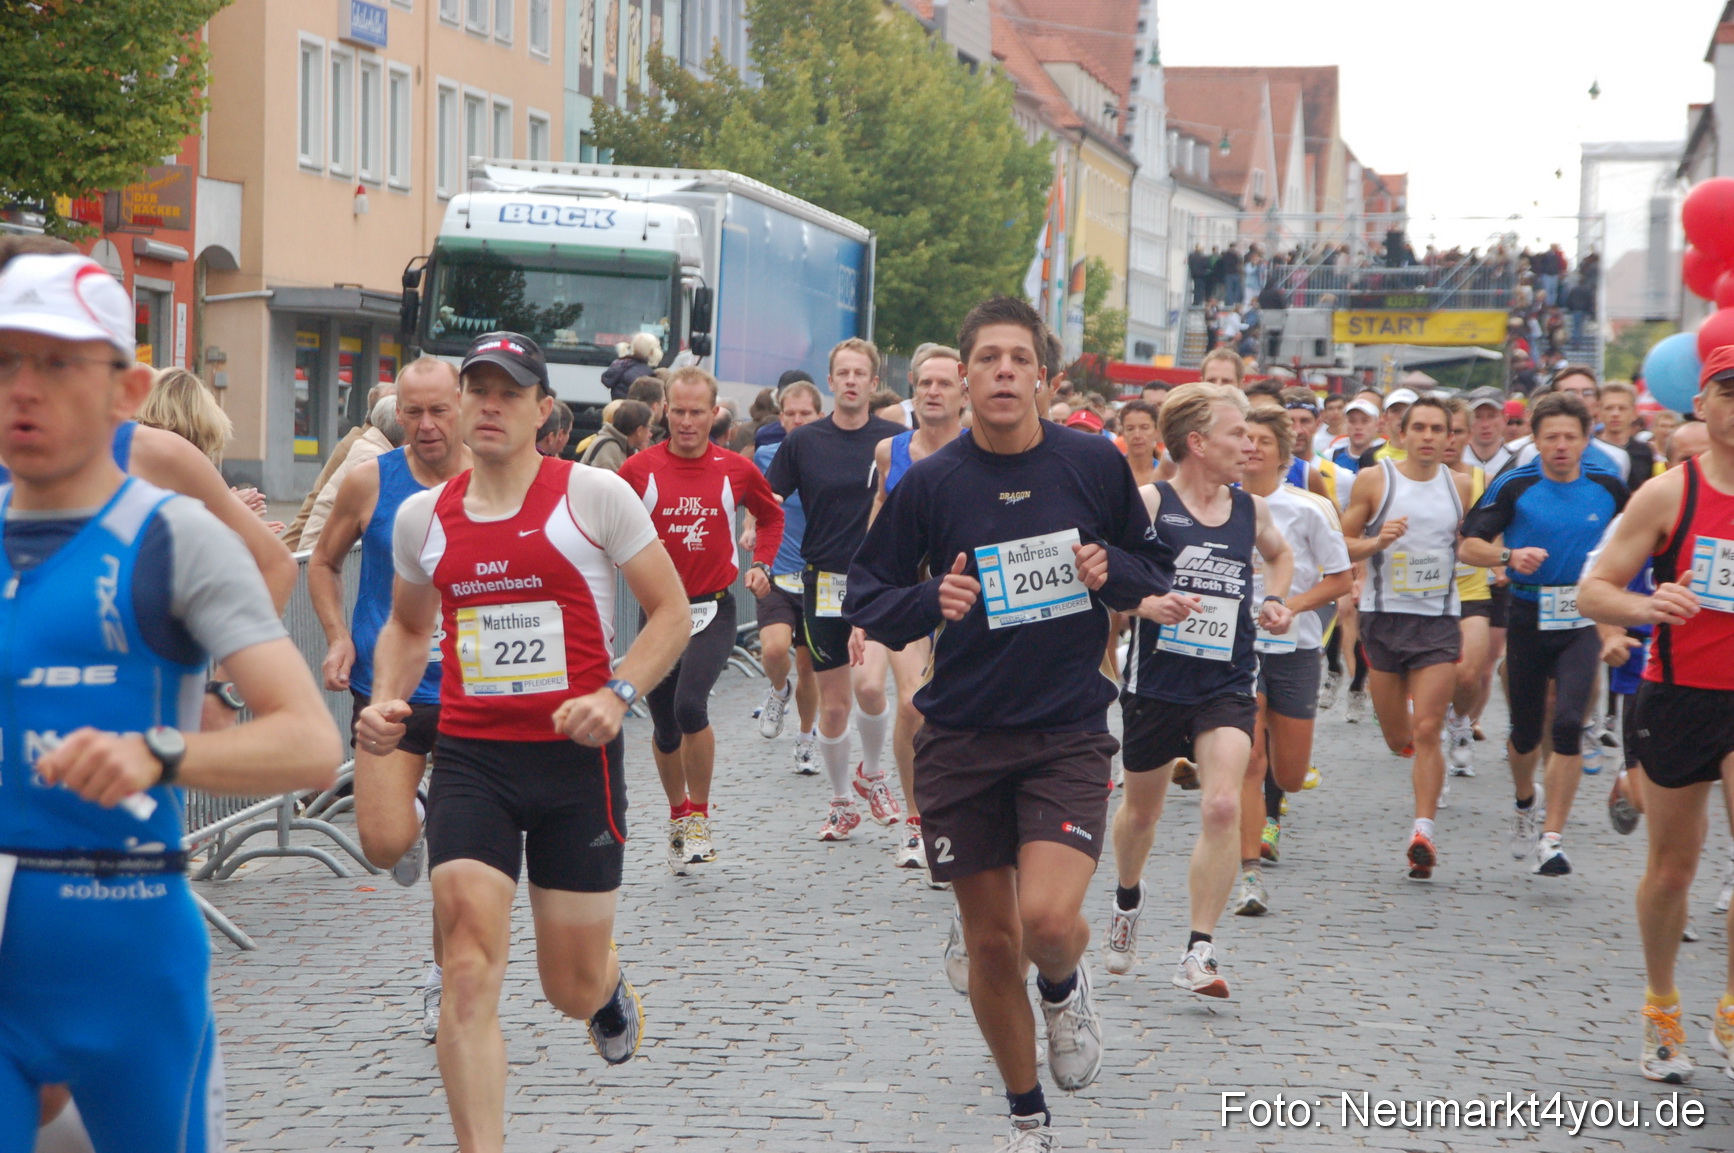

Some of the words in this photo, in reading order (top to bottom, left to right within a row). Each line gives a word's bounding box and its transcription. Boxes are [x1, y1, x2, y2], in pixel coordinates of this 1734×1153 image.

[499, 203, 617, 229] BOCK
[1348, 316, 1429, 336] START
[679, 497, 703, 512] DJK
[999, 490, 1031, 501] DRAGON
[1008, 545, 1059, 565] Andreas
[1409, 556, 1439, 565] Joachim
[475, 560, 509, 576] DAV
[1185, 557, 1242, 578] NAGEL
[1415, 568, 1439, 583] 744
[451, 575, 543, 597] Röthenbach
[990, 577, 996, 588] A
[1013, 563, 1074, 595] 2043
[1192, 577, 1222, 591] Roth
[1225, 582, 1241, 594] 52
[1719, 568, 1734, 587] 3
[690, 608, 707, 616] ang
[1051, 598, 1089, 613] PFLEIDERER
[1560, 600, 1577, 612] 29
[483, 612, 541, 631] Matthias
[1185, 618, 1228, 638] 2702
[462, 643, 468, 655] A
[494, 639, 546, 666] 222
[17, 664, 118, 687] JBE
[934, 836, 955, 864] 2
[60, 879, 168, 899] sobotka
